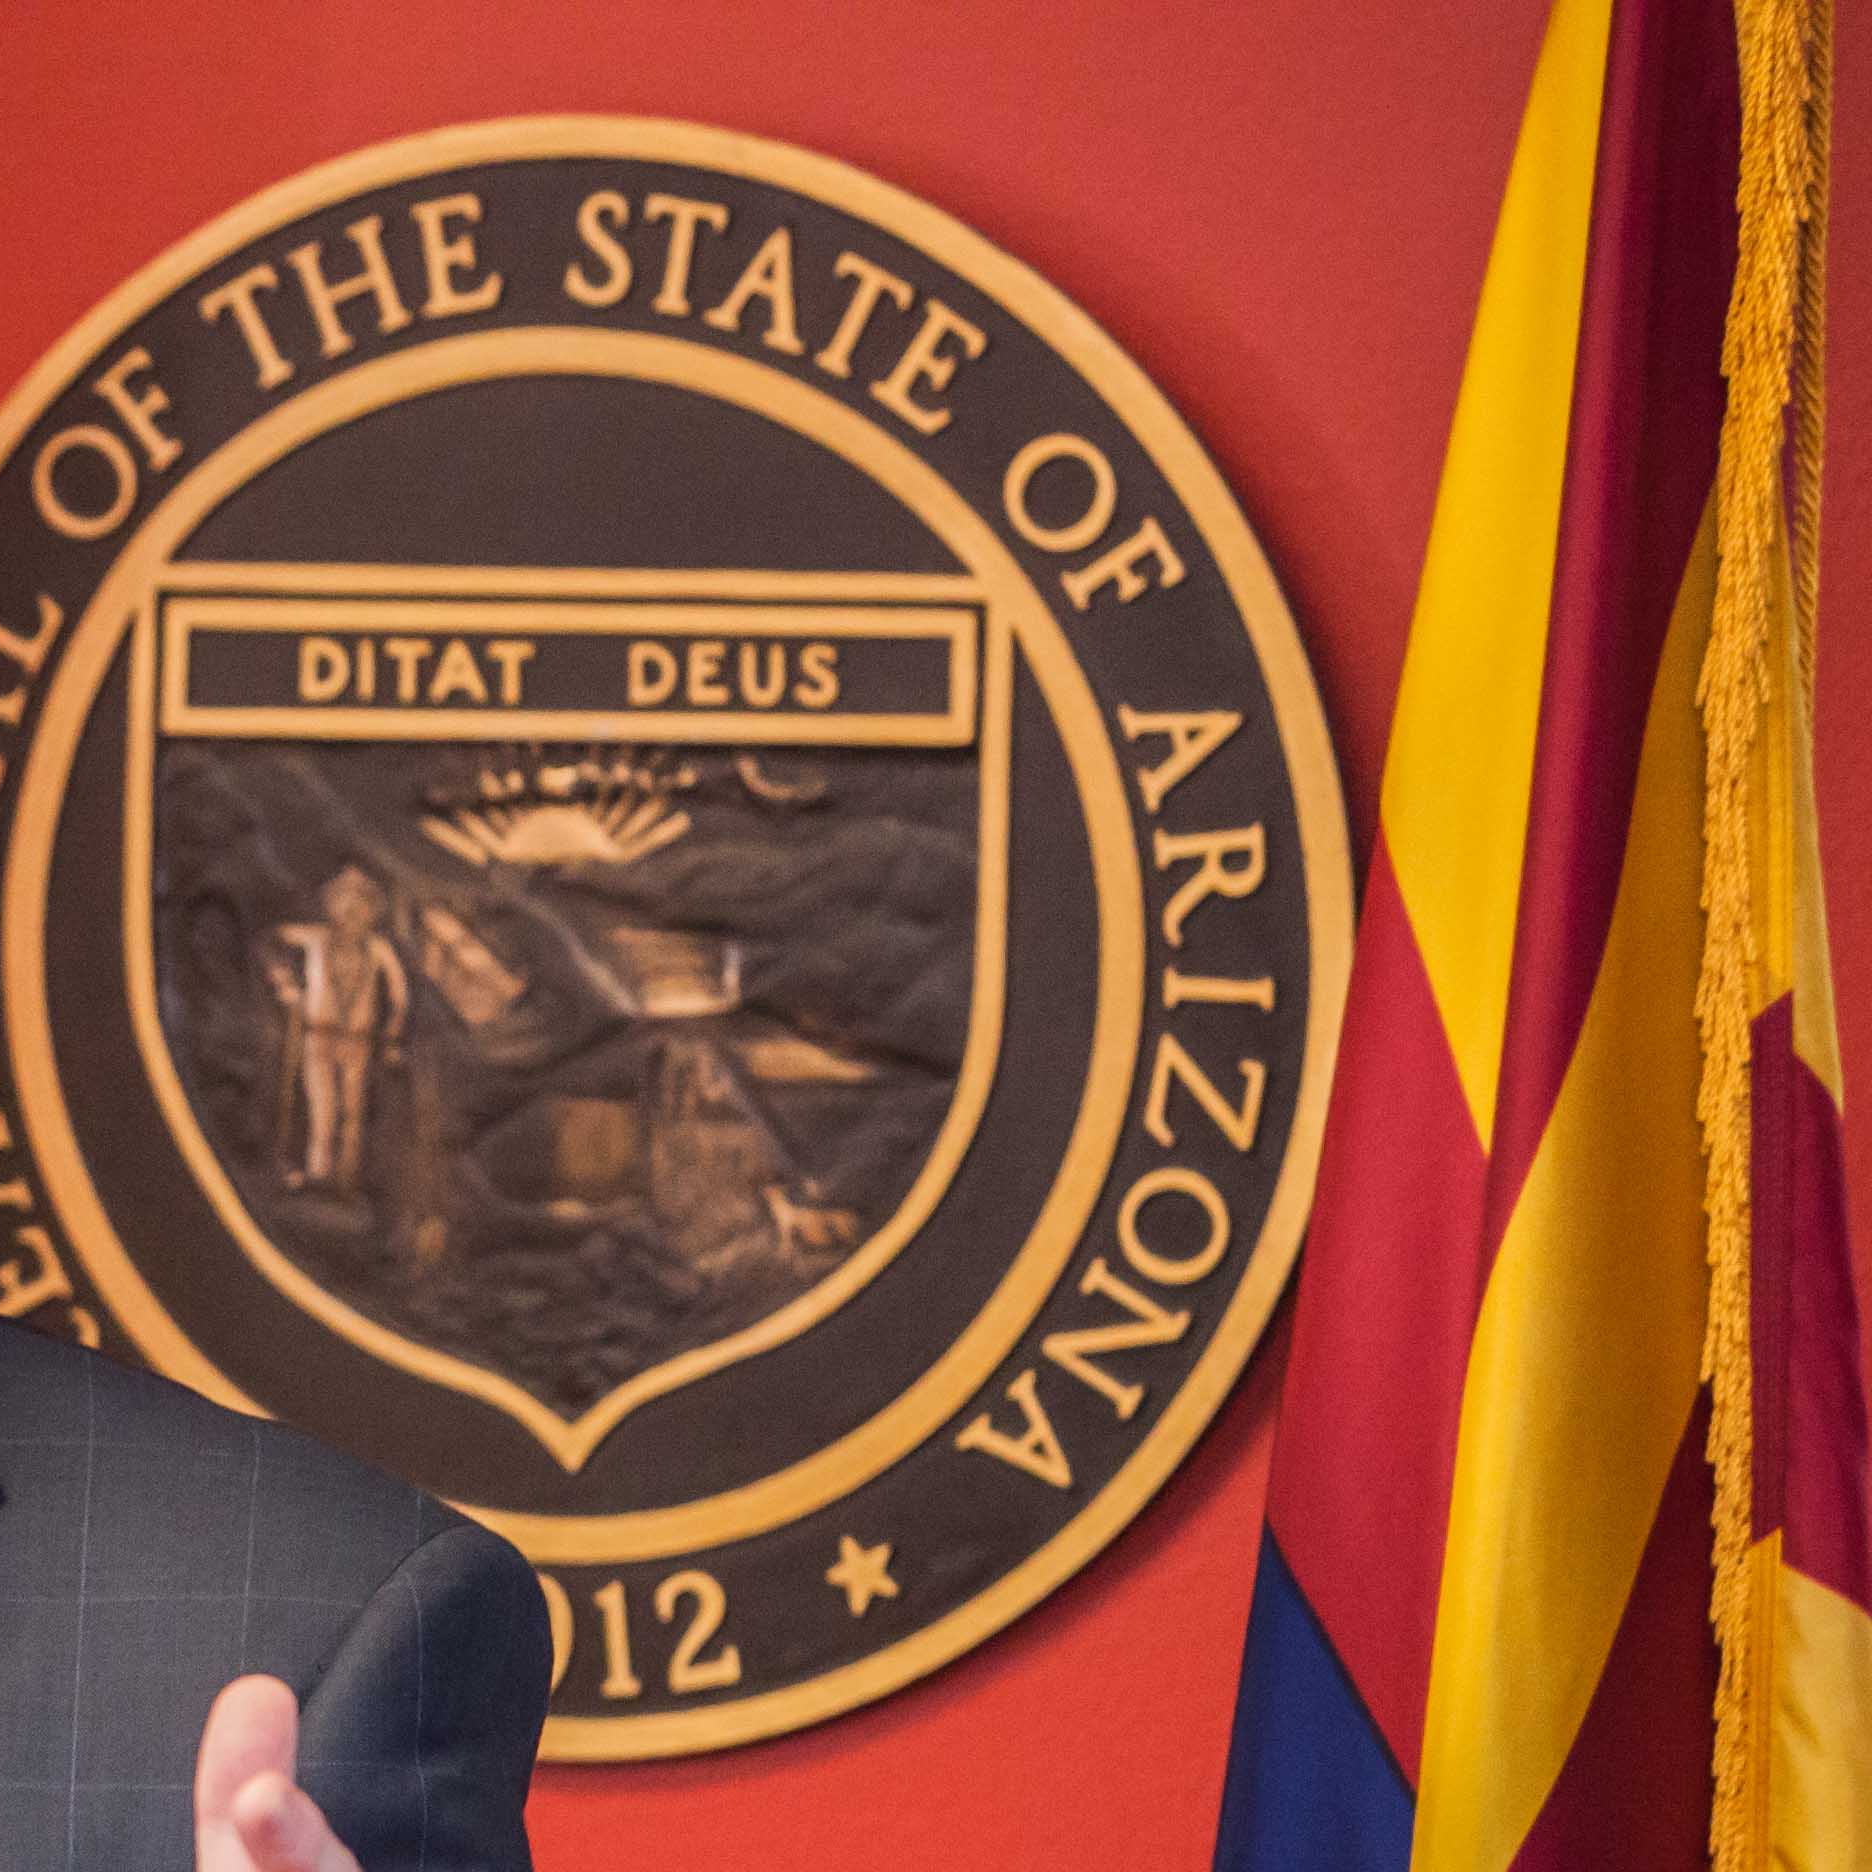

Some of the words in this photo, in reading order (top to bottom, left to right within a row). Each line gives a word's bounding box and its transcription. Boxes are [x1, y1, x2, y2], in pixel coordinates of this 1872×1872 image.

[199, 190, 505, 390] THE
[561, 189, 989, 436] STATE
[31, 346, 186, 542] OF
[1001, 430, 1187, 613] OF
[297, 635, 537, 708] DITAT
[626, 640, 841, 710] DEUS
[953, 702, 1278, 1494] ARIZONA
